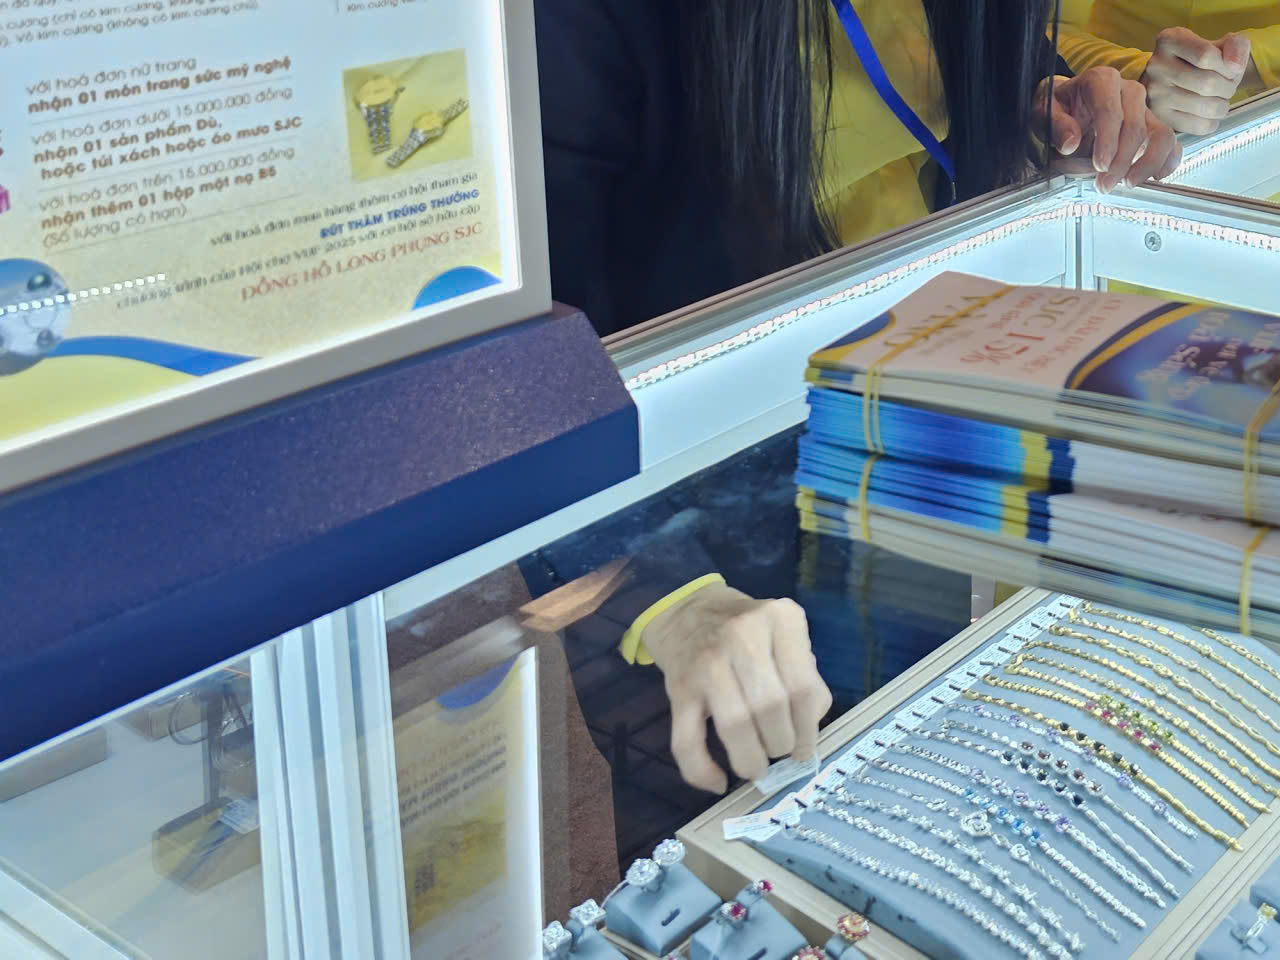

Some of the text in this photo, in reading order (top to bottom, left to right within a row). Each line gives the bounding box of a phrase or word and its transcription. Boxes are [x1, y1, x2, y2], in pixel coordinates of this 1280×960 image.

[153, 57, 198, 74] trang
[27, 96, 73, 114] nhận
[77, 91, 97, 106] 01
[103, 82, 142, 101] món
[145, 74, 191, 93] trang
[33, 145, 79, 165] nhận
[83, 140, 103, 154] 01
[119, 144, 161, 164] xách
[274, 116, 304, 132] SJC
[138, 192, 157, 207] 01
